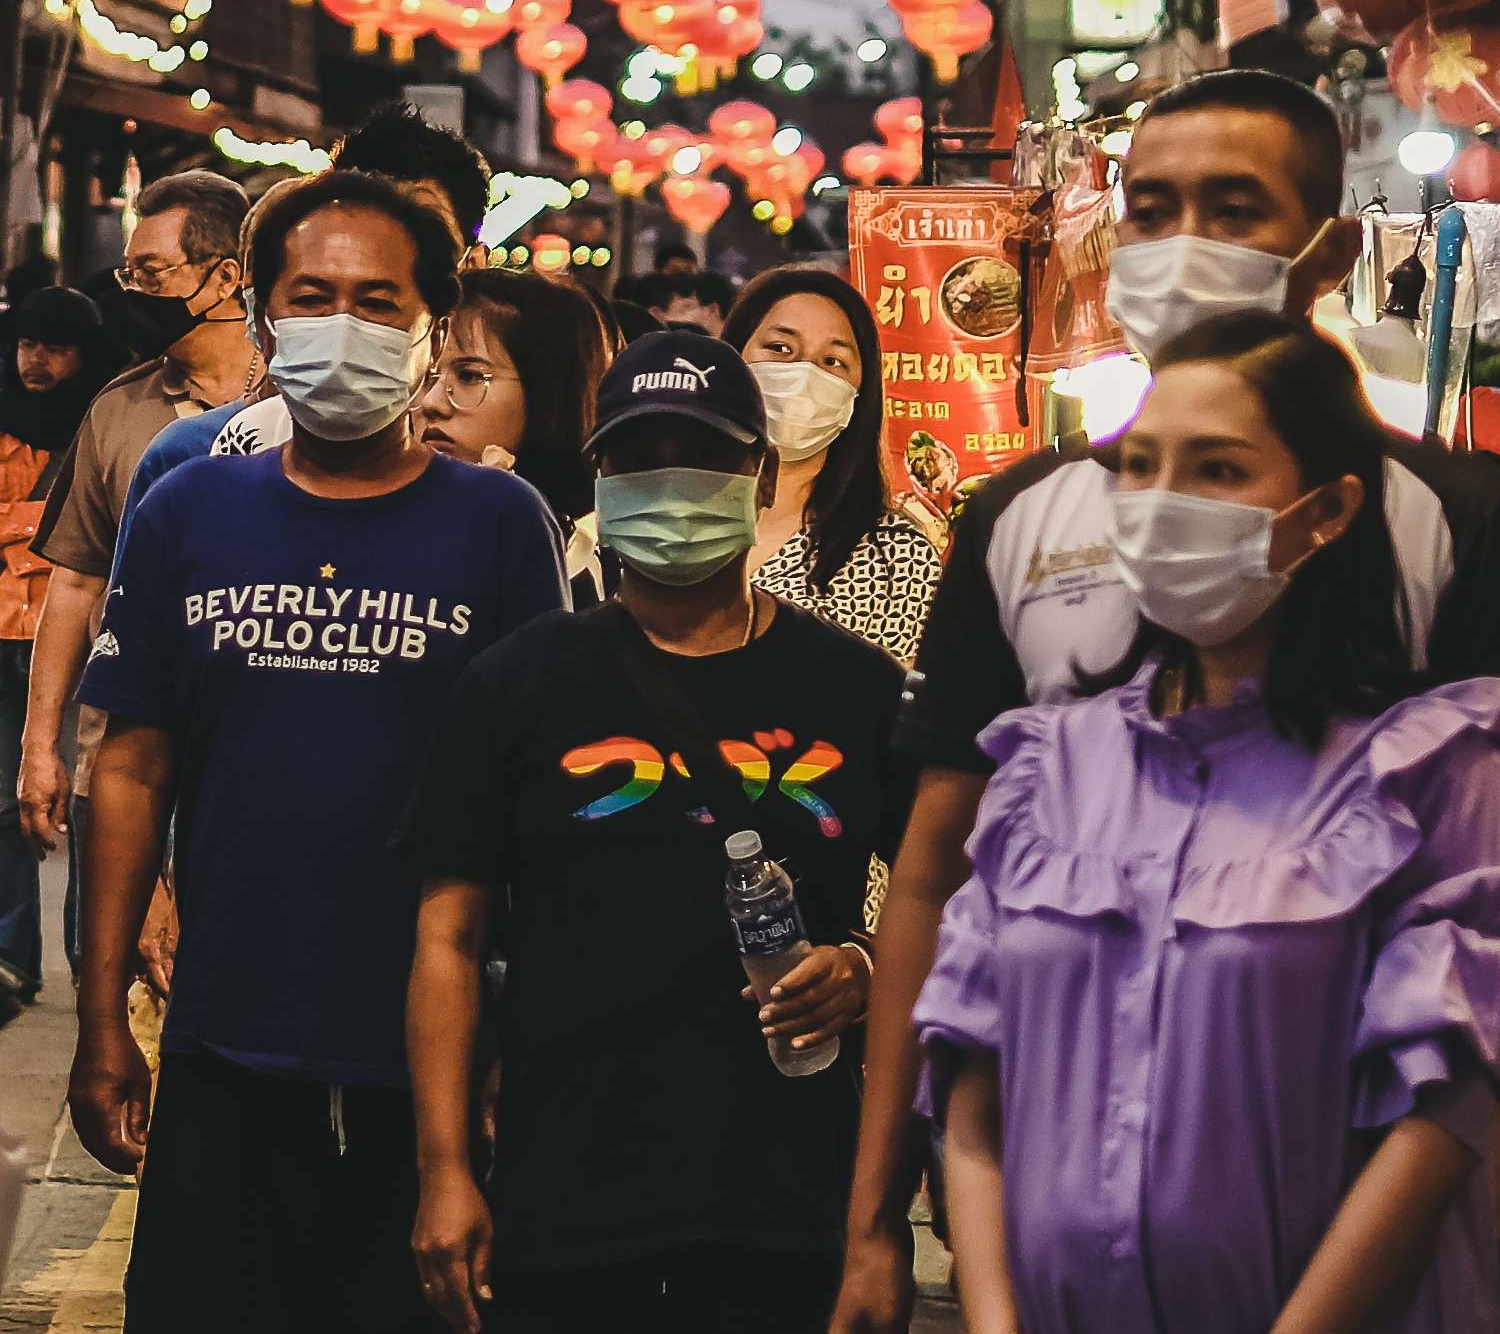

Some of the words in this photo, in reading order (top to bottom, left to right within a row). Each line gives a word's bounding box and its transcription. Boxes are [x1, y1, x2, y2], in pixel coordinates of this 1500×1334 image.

[907, 208, 986, 240] เจ้าเก่า
[631, 371, 698, 394] PUMA
[882, 351, 1021, 383] หอยดอ
[184, 583, 353, 627] BEVERLY
[357, 586, 473, 636] HILLS
[212, 618, 315, 652] POLO
[320, 622, 428, 659] CLUB
[247, 652, 338, 672] Established
[342, 658, 381, 674] 1982
